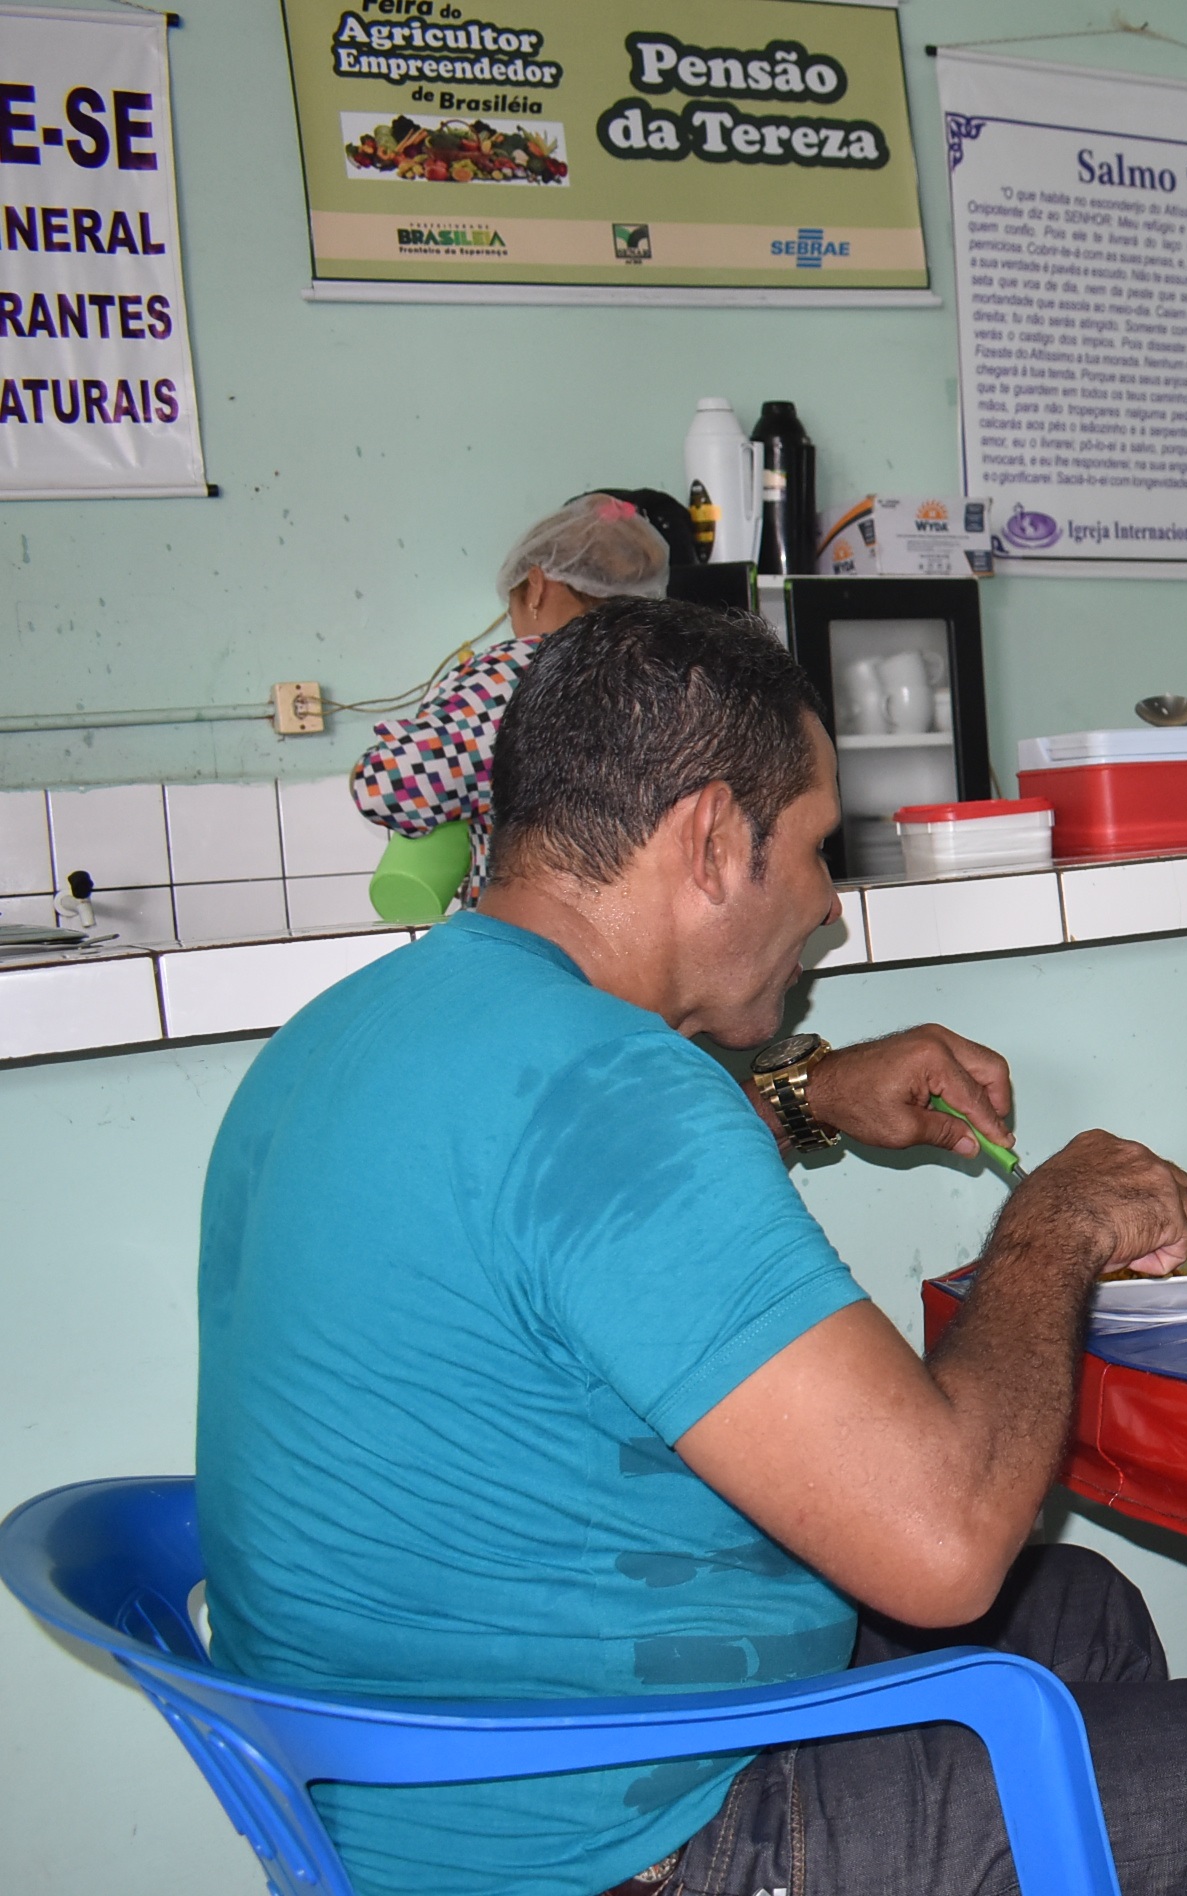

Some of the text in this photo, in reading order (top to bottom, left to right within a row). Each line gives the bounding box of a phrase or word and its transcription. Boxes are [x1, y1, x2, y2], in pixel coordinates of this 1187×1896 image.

[440, 4, 461, 19] do
[339, 16, 538, 52] Agricultor
[337, 48, 557, 83] Empreendedor
[636, 42, 838, 94] Pensão
[412, 86, 543, 114] de Brasiléia
[0, 83, 158, 171] E-SE
[608, 108, 879, 160] da Tereza
[1077, 148, 1176, 193] Salmo
[0, 206, 166, 255] NERAL
[770, 240, 850, 257] SEBRAE
[0, 292, 172, 340] RANTES
[1068, 520, 1110, 543] Igreja
